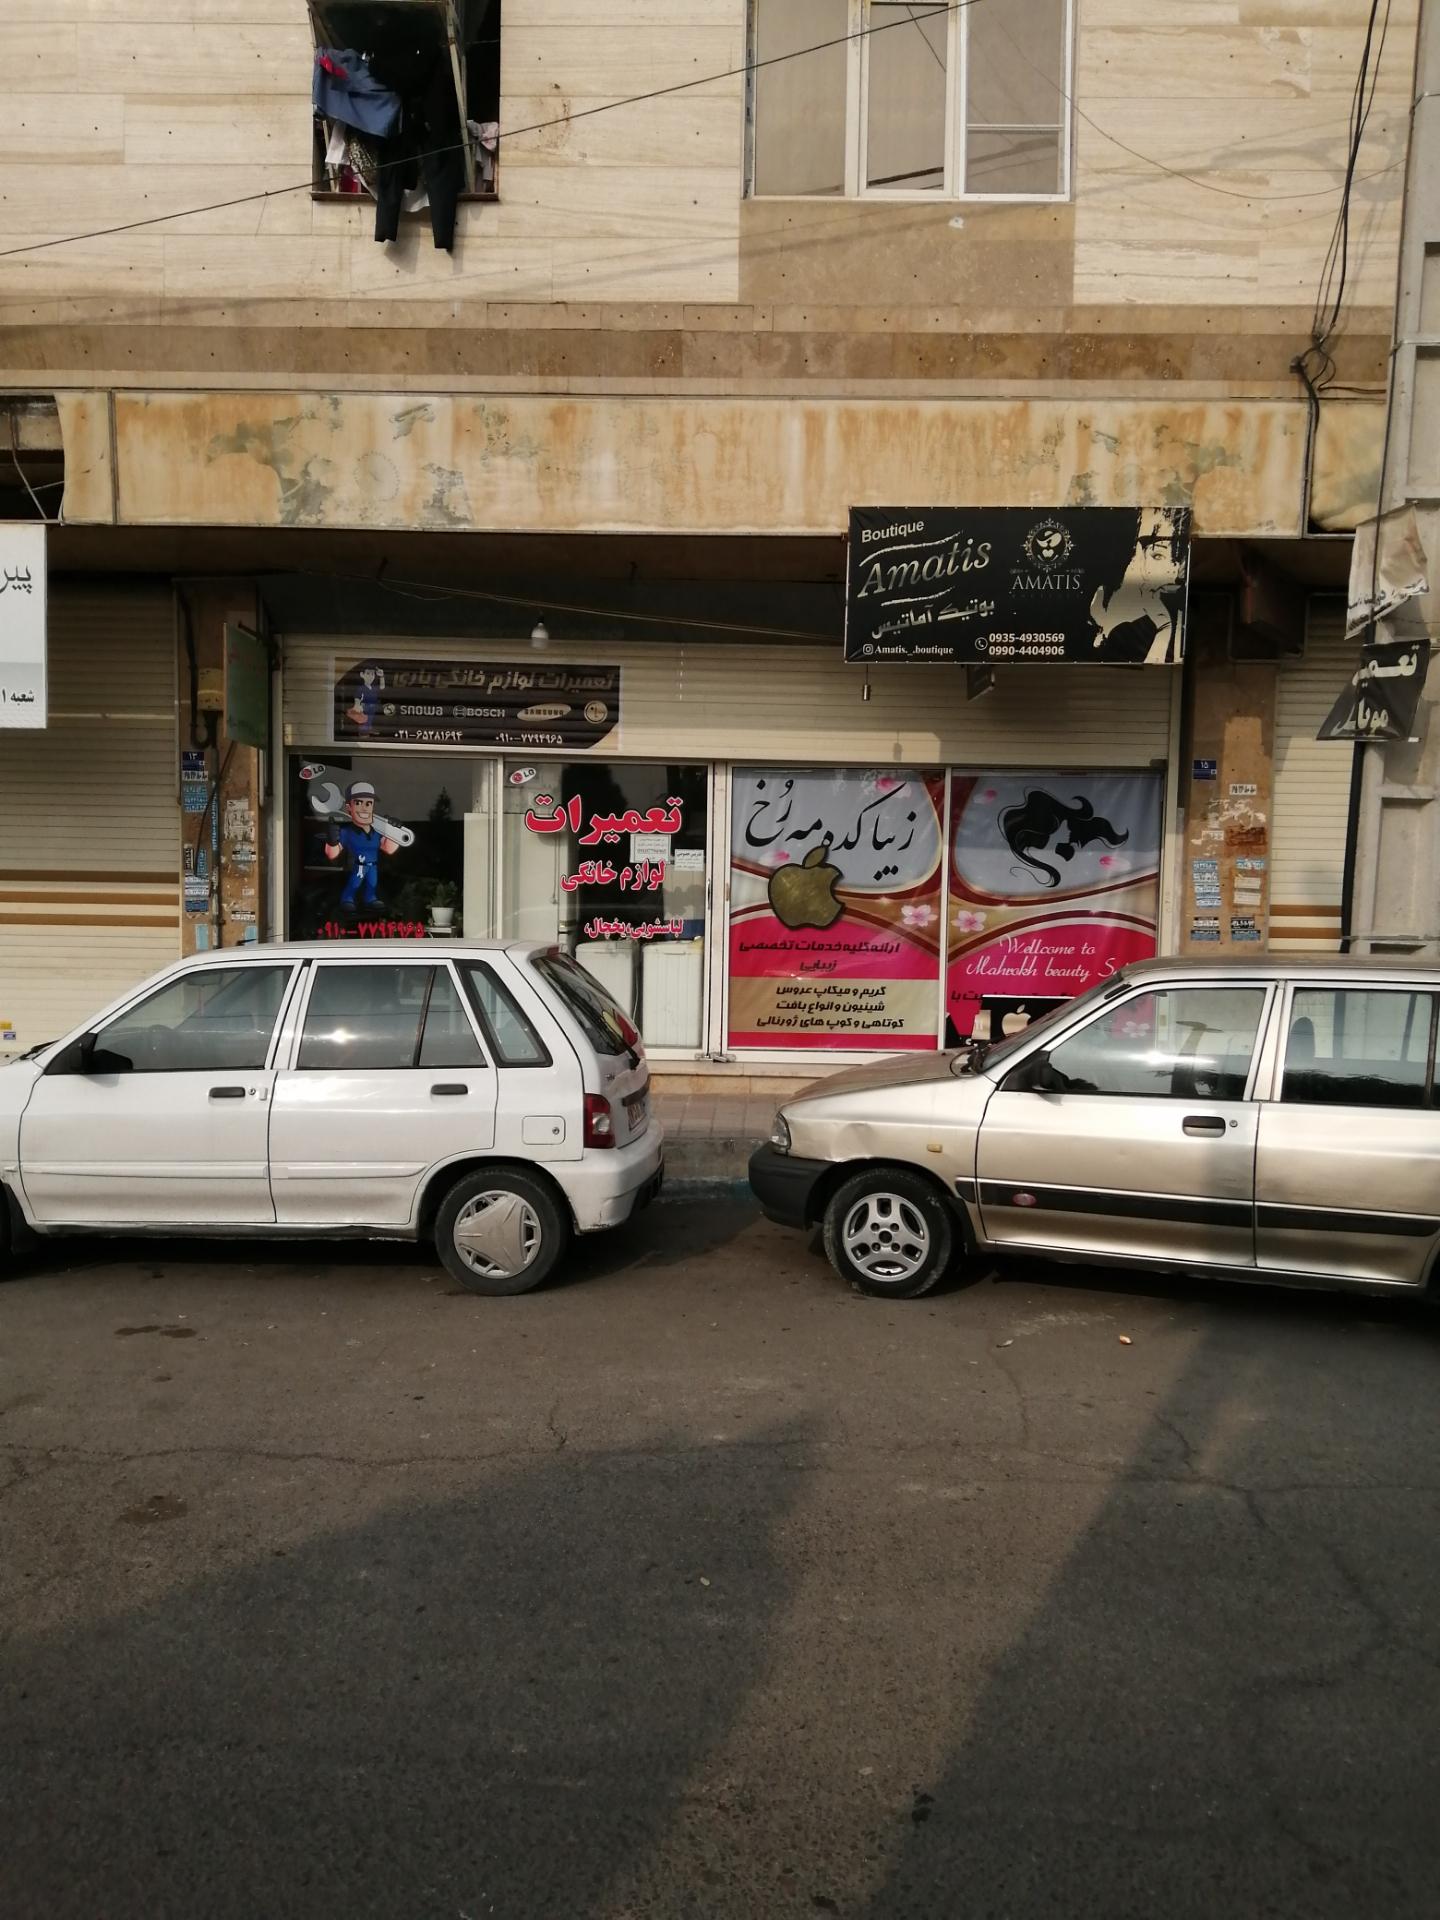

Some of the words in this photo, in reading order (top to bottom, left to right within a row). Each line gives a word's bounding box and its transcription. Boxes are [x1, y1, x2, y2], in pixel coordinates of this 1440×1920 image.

[861, 520, 925, 543] Boutique
[857, 538, 992, 598] Amatis
[1012, 575, 1080, 590] AMATIS
[937, 598, 995, 621] بوتیک
[871, 604, 934, 639] آماتیس
[989, 632, 1065, 643] 0935-4930569
[989, 645, 1065, 656] 0990-4404906
[435, 669, 485, 690] خانگی
[487, 671, 535, 695] لوازم
[538, 672, 616, 694] تعمیرات
[10, 689, 35, 706] شعبه
[466, 708, 506, 718] BOSCH
[523, 708, 565, 717] SAMSUNG
[313, 765, 324, 775] LG
[523, 769, 535, 778] LG
[525, 794, 684, 845] تعمیرات
[560, 860, 618, 892] خانگی
[619, 858, 667, 891] لوازم
[739, 940, 794, 952] تخصصی
[795, 939, 842, 951] خدمات
[843, 942, 871, 955] کلیه
[1081, 942, 1096, 955] to
[966, 956, 1038, 976] Mahrokh
[1044, 957, 1092, 983] beauty
[776, 986, 813, 996] عروس
[814, 986, 851, 998] میکاپ
[852, 988, 859, 996] و
[776, 1000, 807, 1012] بافت
[808, 1001, 833, 1014] انواع
[834, 1003, 841, 1012] و
[842, 1000, 885, 1013] شینیون
[756, 1015, 799, 1027] ژورنالی
[800, 1017, 825, 1028] های
[826, 1018, 853, 1030] کوپ
[853, 1019, 860, 1028] و
[861, 1018, 905, 1029] کوتاهی
